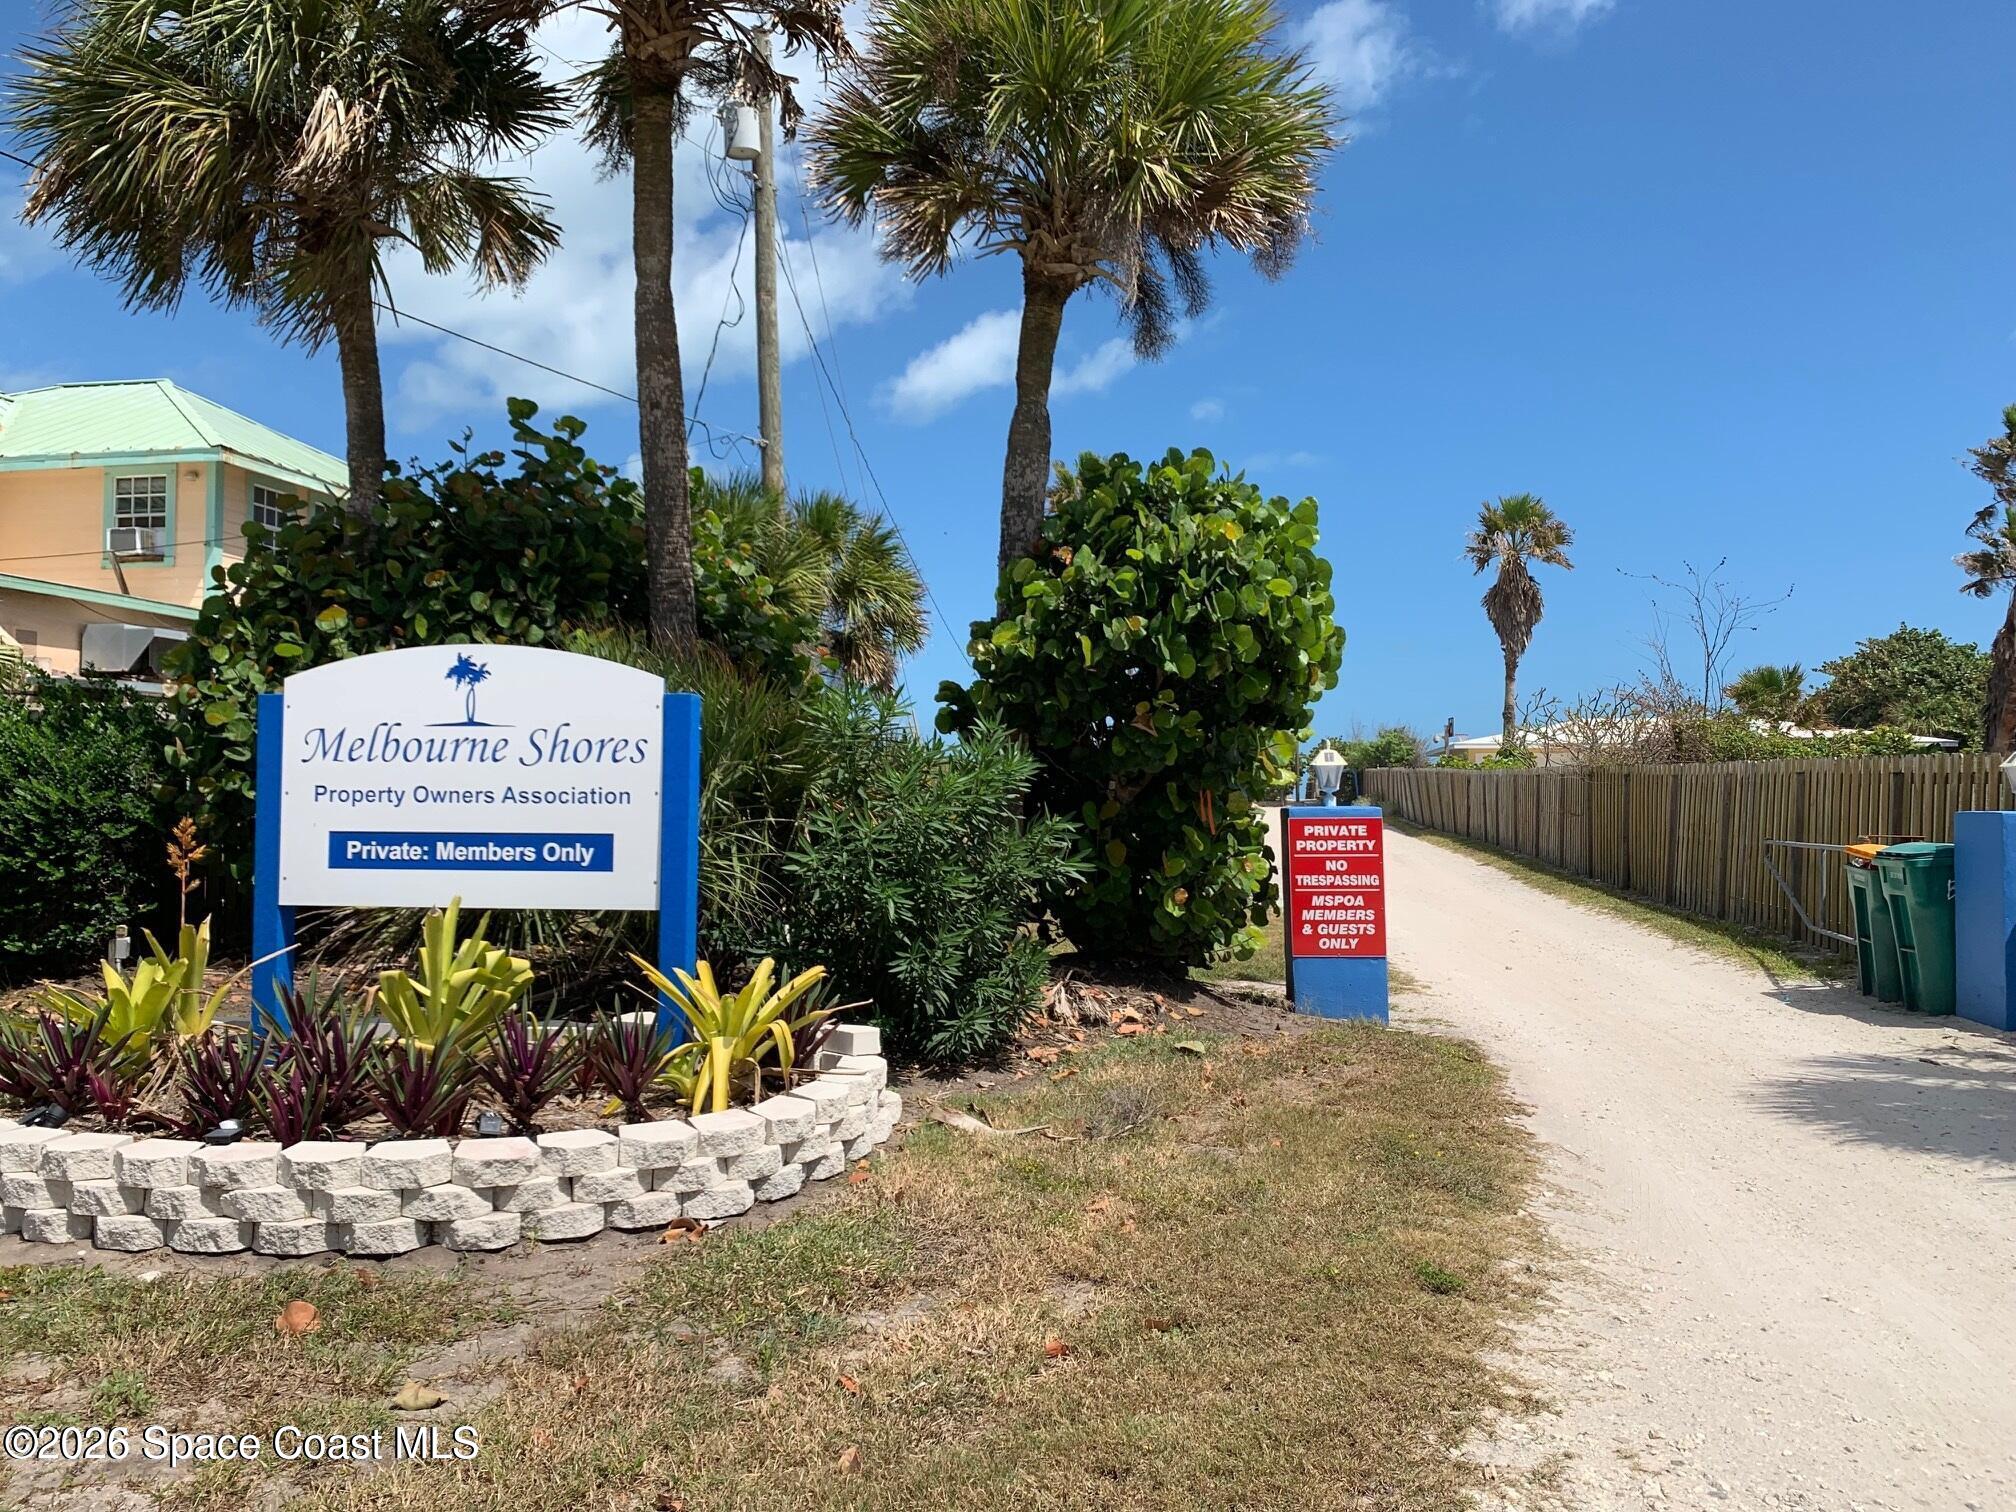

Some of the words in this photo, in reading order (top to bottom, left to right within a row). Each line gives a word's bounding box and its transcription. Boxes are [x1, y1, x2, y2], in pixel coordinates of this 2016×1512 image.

[301, 722, 509, 764] Melbourne
[519, 722, 649, 766] Shores
[314, 784, 405, 808] Property
[413, 785, 495, 805] Owners
[501, 786, 632, 805] Association
[1303, 825, 1368, 837] PRIVATE
[1296, 839, 1376, 851] PROPERTY
[346, 840, 429, 861] Private:
[436, 841, 536, 862] Members
[543, 842, 595, 867] Only
[1325, 860, 1348, 872] NO
[1295, 874, 1380, 886] TRESPASSING
[1311, 895, 1364, 907] MSPOA
[1301, 909, 1375, 921] MEMBERS
[1302, 924, 1313, 935] &
[1317, 923, 1376, 935] GUESTS
[1318, 938, 1359, 950] ONLY
